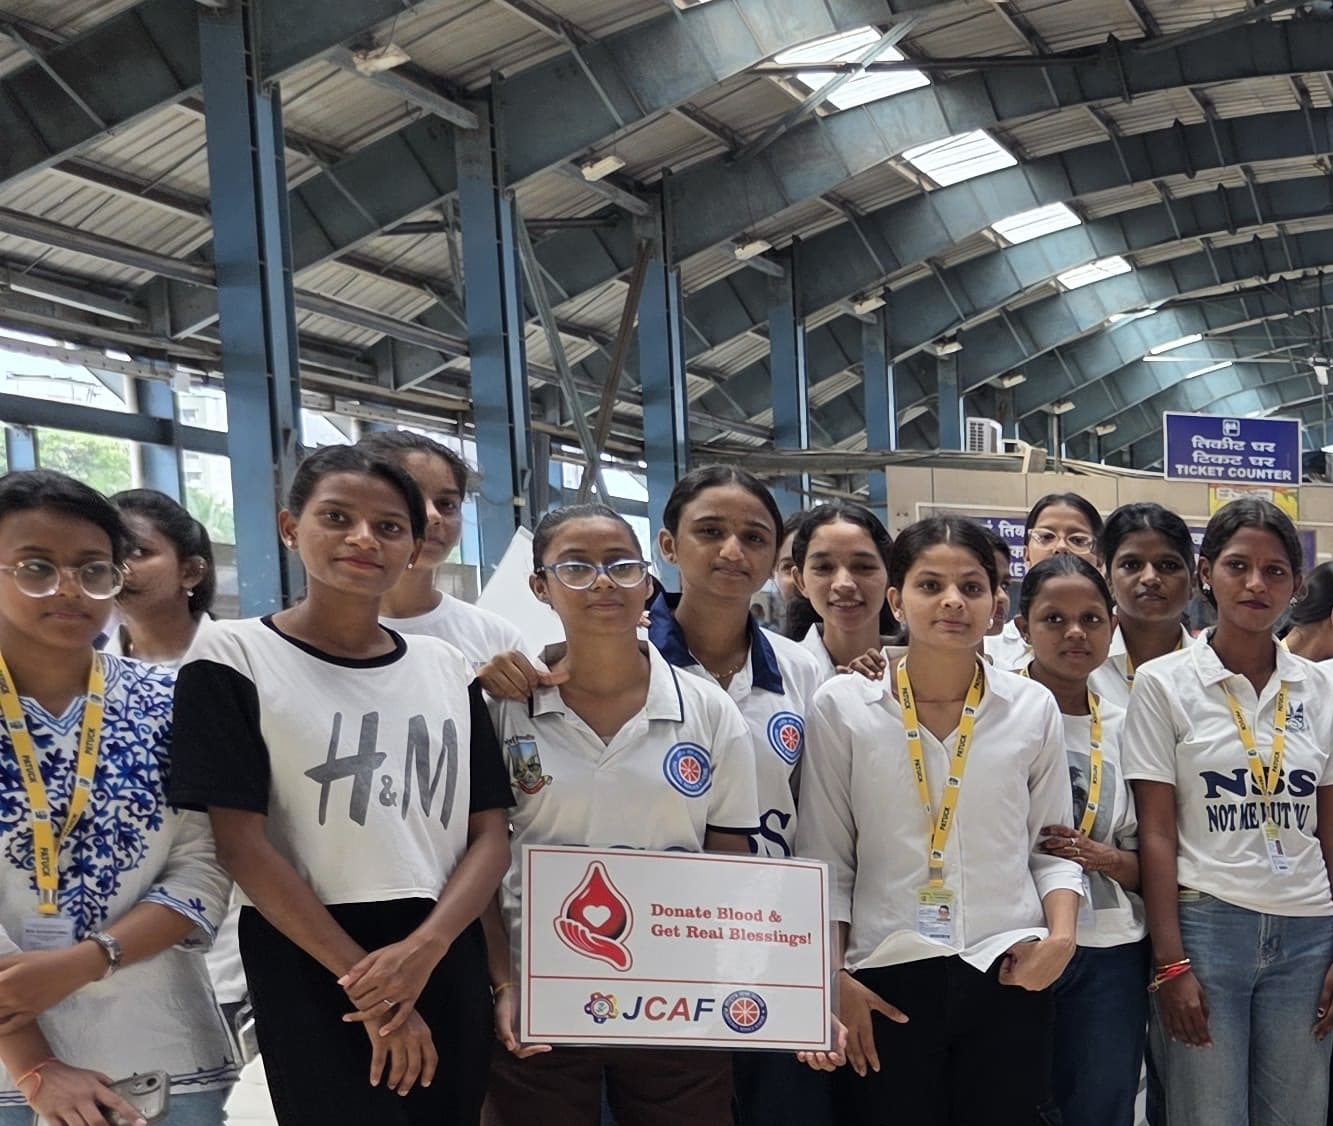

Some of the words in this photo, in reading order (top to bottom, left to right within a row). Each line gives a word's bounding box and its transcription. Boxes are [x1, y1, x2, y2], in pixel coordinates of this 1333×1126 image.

[1175, 464, 1225, 477] TICKET
[1228, 467, 1292, 481] COUNTER
[901, 687, 911, 710] PATUCK
[84, 727, 96, 755] PATUCK
[956, 735, 967, 758] PATUCK
[21, 754, 37, 784] PATUCK
[304, 711, 459, 830] H&M
[914, 759, 923, 783] PATUCK
[939, 807, 950, 831] PATUCK
[1206, 804, 1238, 832] NOT
[1239, 802, 1259, 830] ME
[40, 847, 49, 877] PATUCK
[650, 903, 712, 919] Donate
[717, 907, 763, 922] Blood
[768, 910, 783, 923] &
[651, 924, 680, 938] Get
[686, 926, 724, 940] Real
[729, 928, 812, 947] Blessings!
[622, 995, 716, 1023] JCAF
